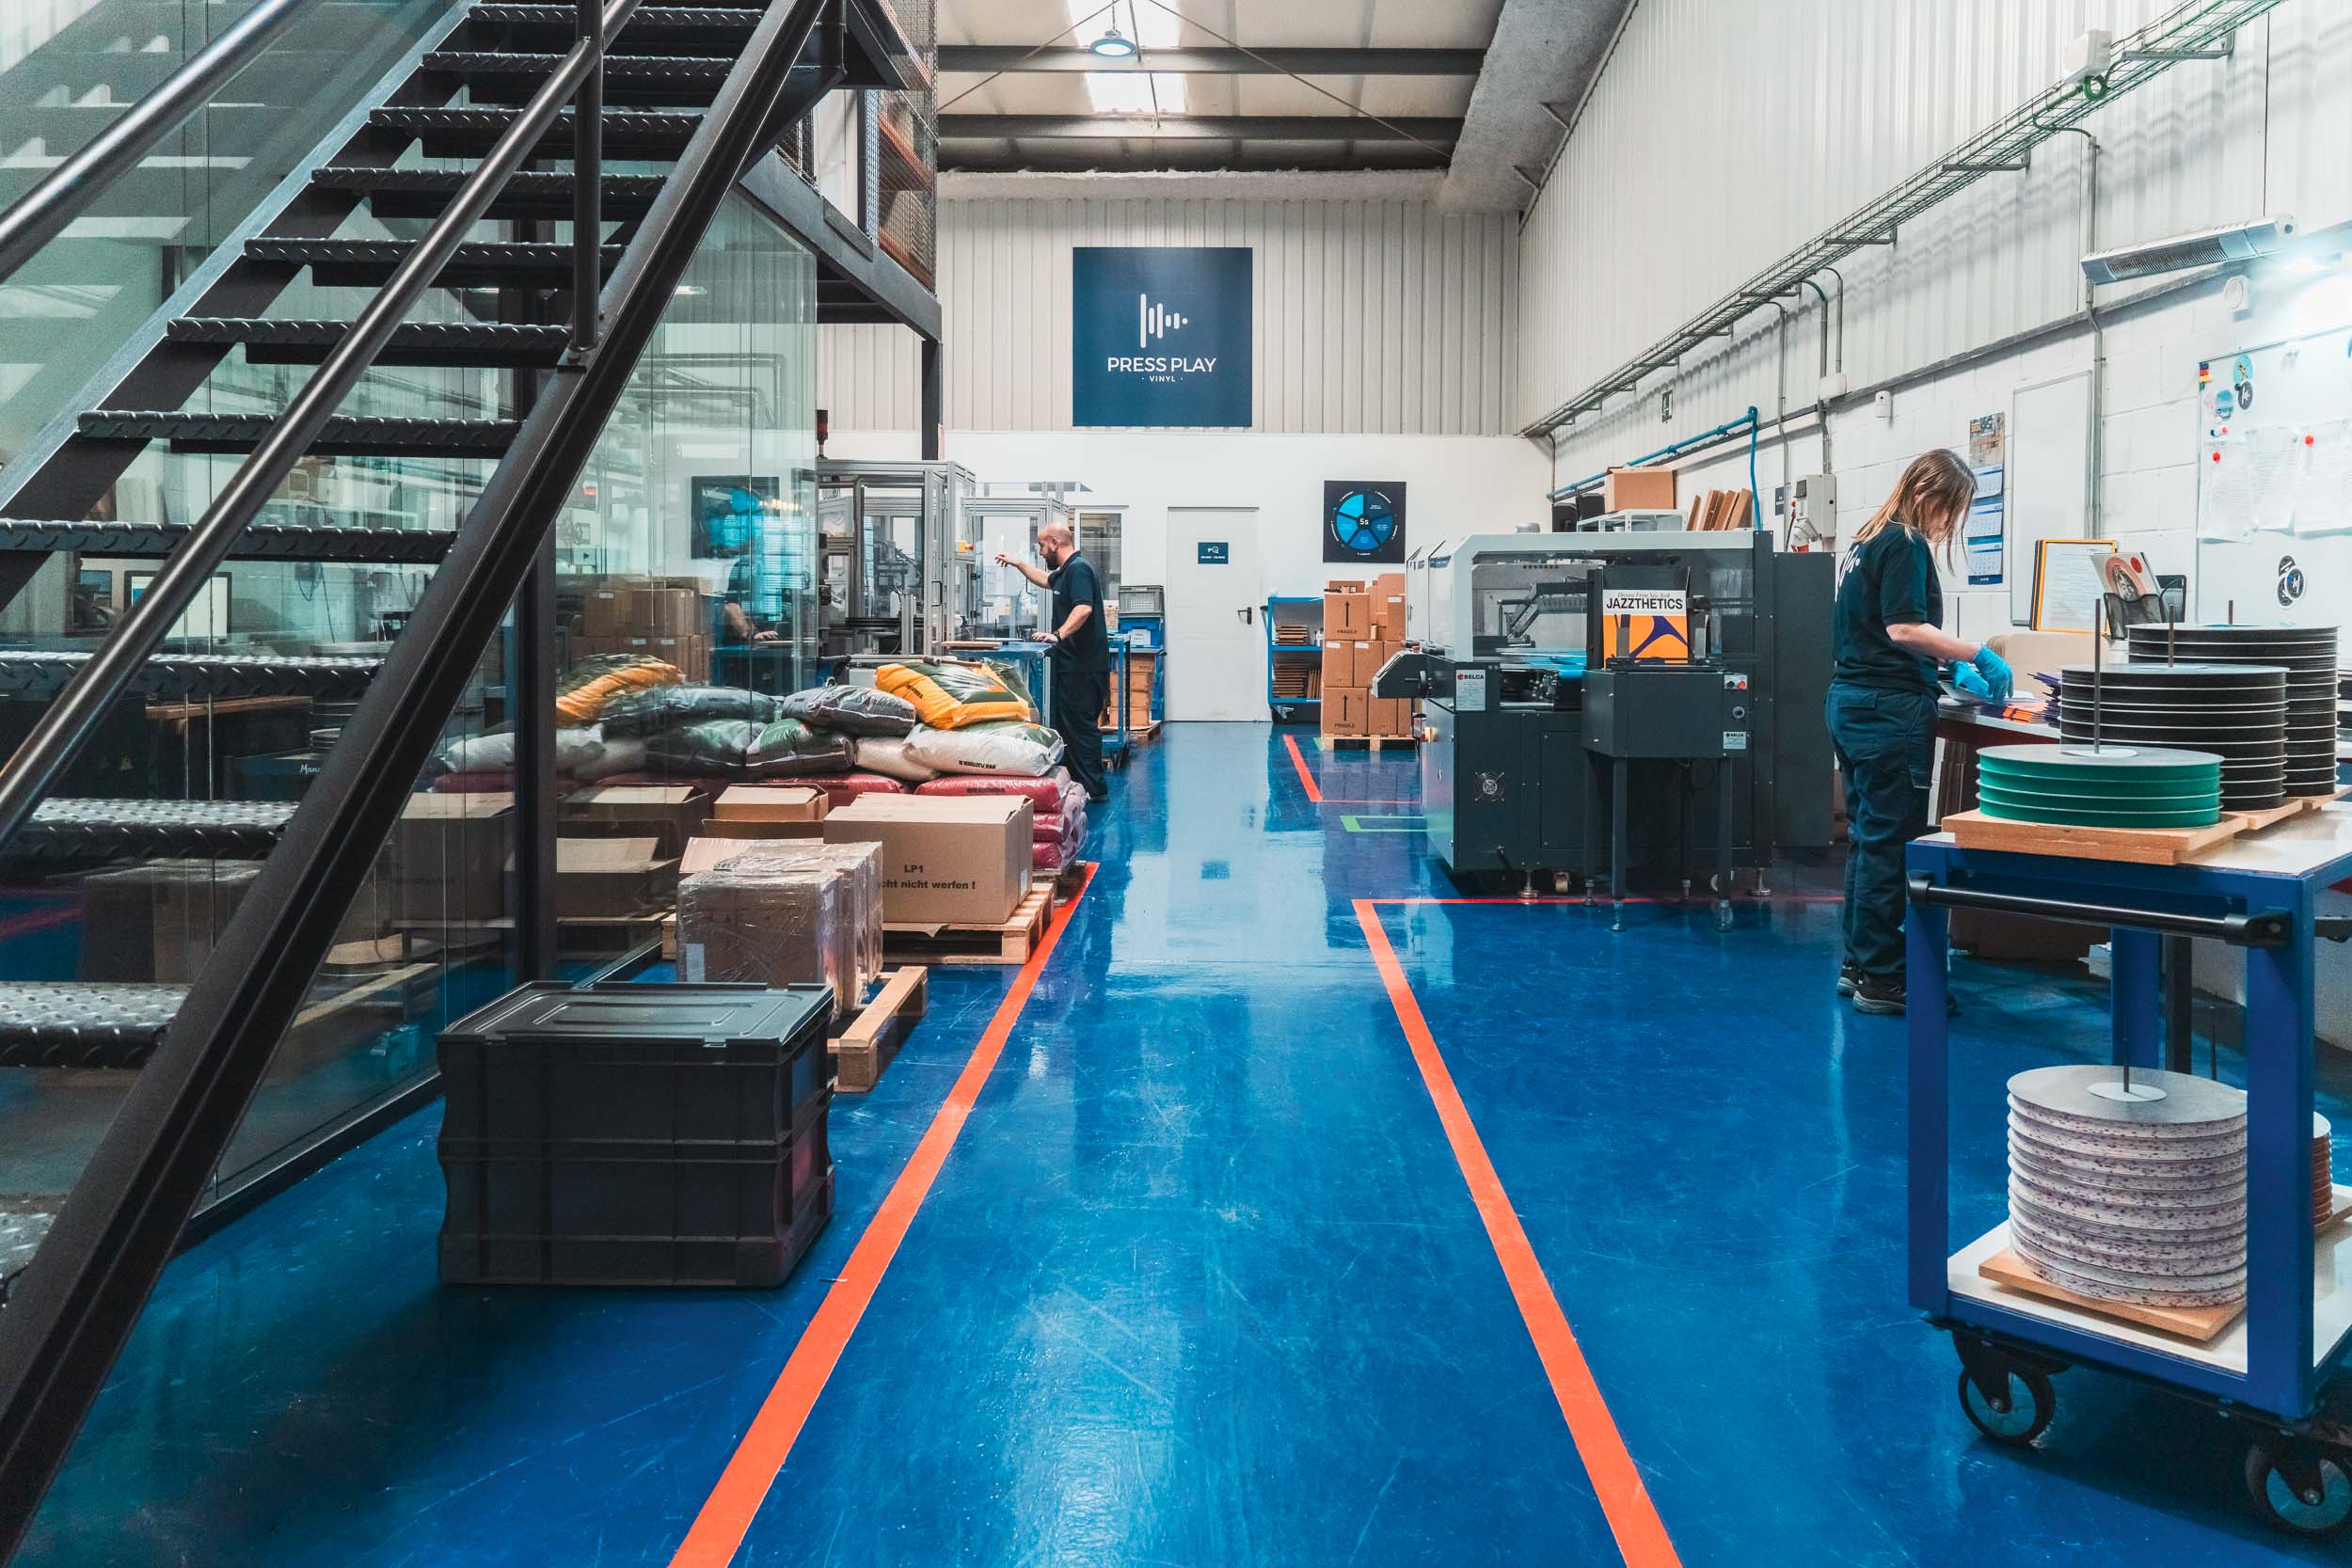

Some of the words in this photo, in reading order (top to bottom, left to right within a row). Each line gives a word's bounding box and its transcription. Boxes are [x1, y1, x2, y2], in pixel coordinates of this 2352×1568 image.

[1107, 356, 1167, 372] PRESS
[1171, 356, 1217, 372] PLAY
[1606, 597, 1683, 610] JAZZTHETICS
[903, 864, 924, 873] LP1
[900, 879, 929, 889] nicht
[931, 880, 969, 890] werfen
